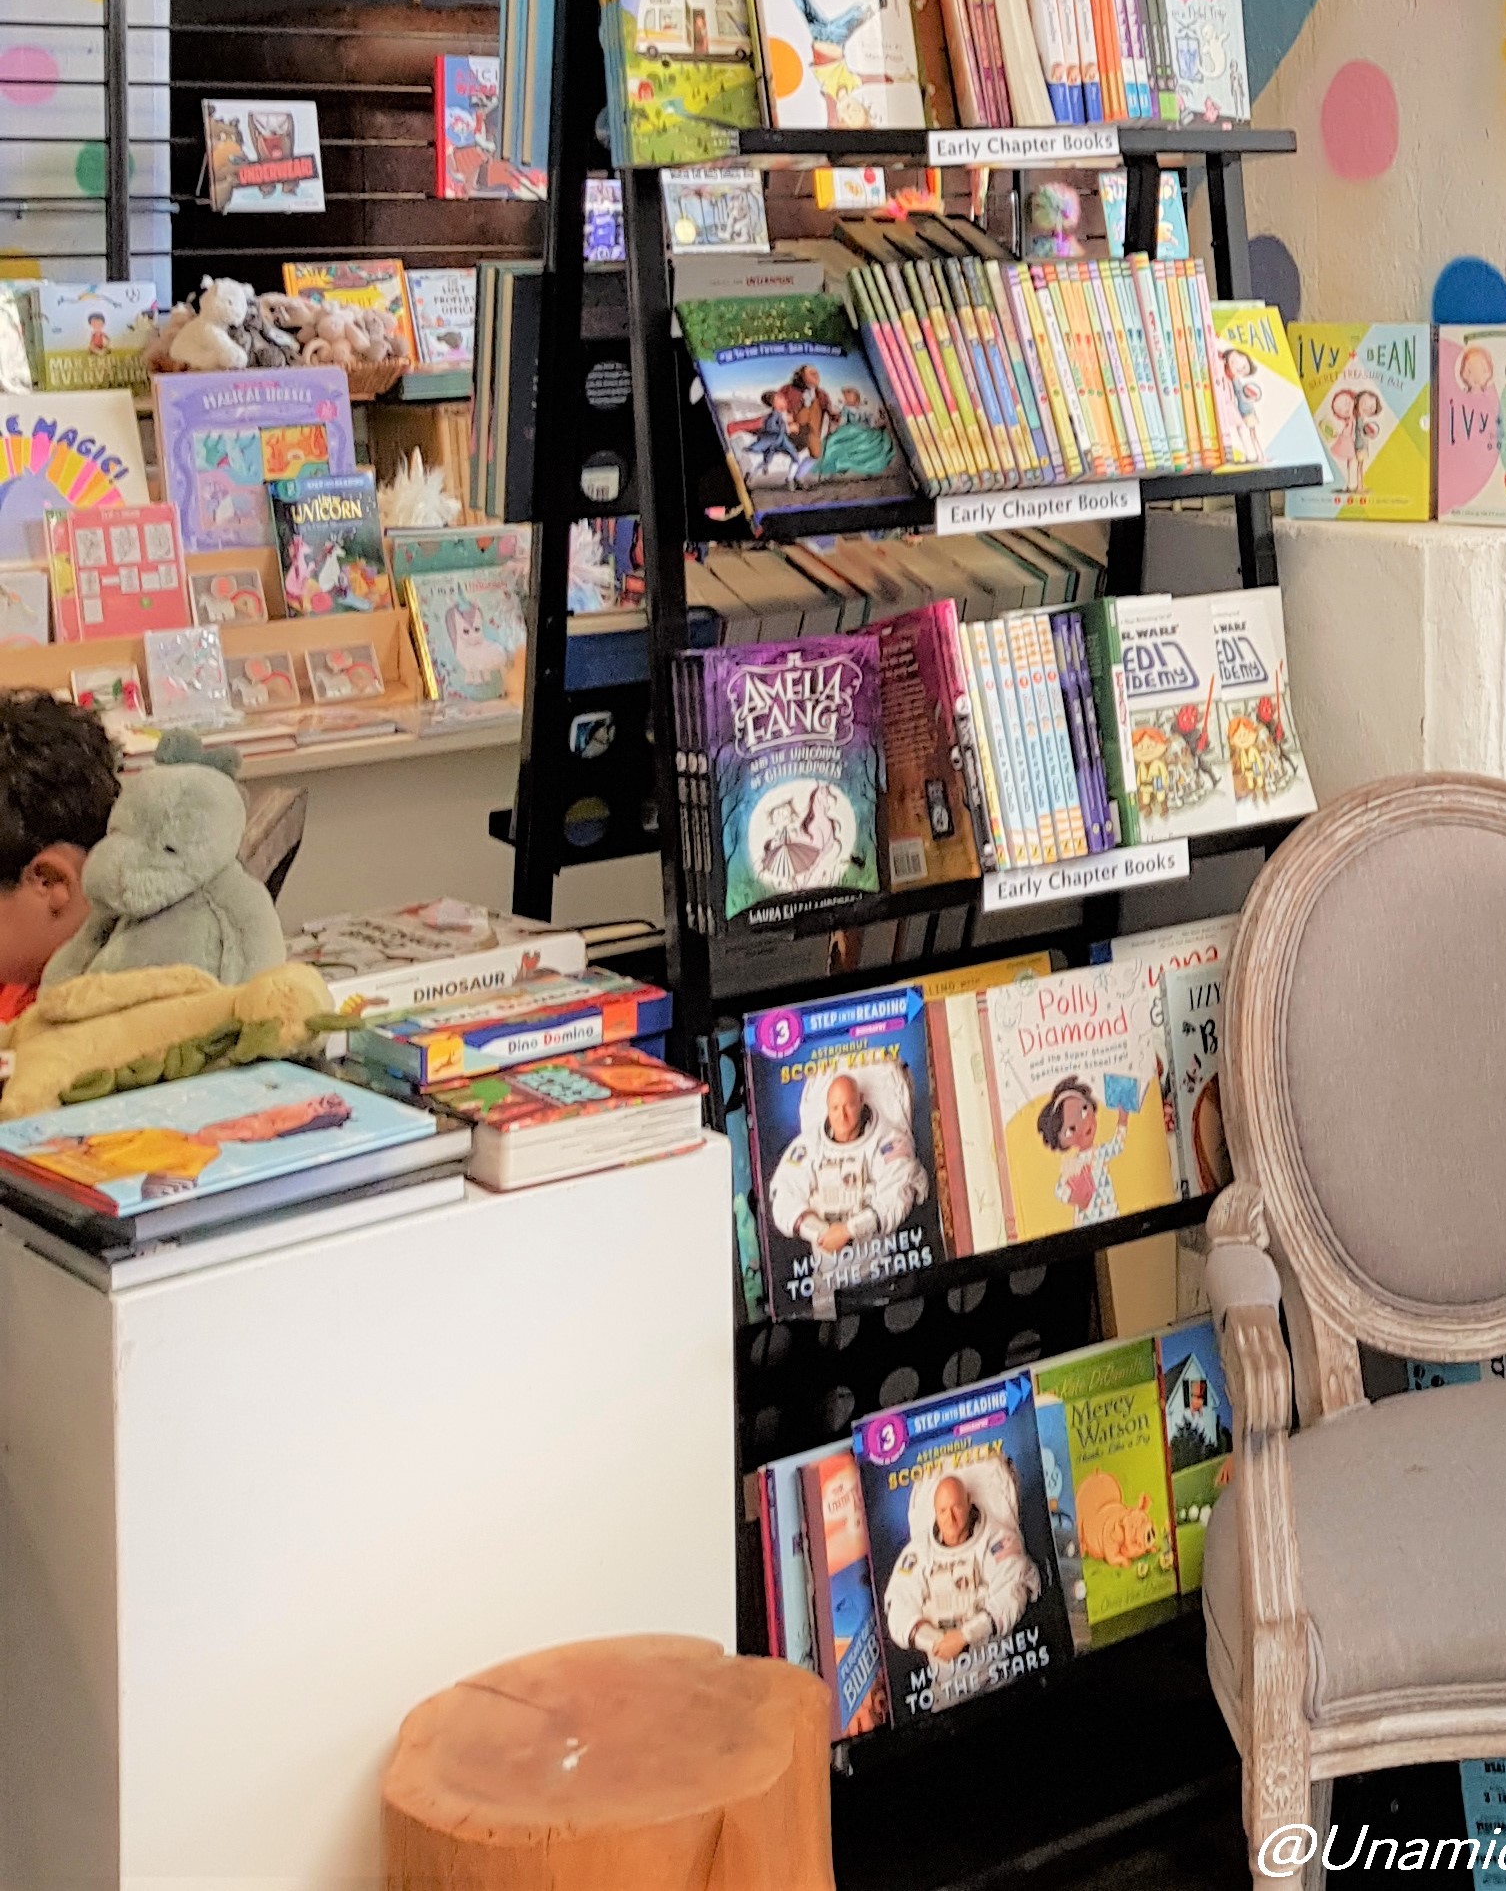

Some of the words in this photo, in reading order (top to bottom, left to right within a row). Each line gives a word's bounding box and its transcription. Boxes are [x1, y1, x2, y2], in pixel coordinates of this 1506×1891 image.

[937, 137, 981, 158] Early
[987, 135, 1056, 155] Chapter
[1063, 132, 1113, 151] Books
[1227, 313, 1277, 355] BEAN
[1366, 335, 1417, 381] BEAN
[292, 501, 362, 524] UNICORN
[950, 507, 996, 524] Early
[1003, 499, 1072, 521] Chapter
[1078, 493, 1128, 513] Books
[743, 664, 844, 712] AMELIA
[745, 703, 840, 746] FANG
[998, 881, 1042, 900] Early
[1049, 866, 1119, 892] Chapter
[1125, 855, 1176, 874] Books
[413, 971, 506, 1005] DINOSAUR
[1037, 983, 1099, 1021] Polly
[774, 1021, 791, 1045] 3
[810, 1011, 837, 1032] STEP
[856, 998, 908, 1022] READING
[1018, 1005, 1129, 1059] Diamond
[507, 1037, 539, 1056] Dino
[544, 1024, 595, 1048] Domino
[811, 1039, 869, 1059] ASTRONAUT
[780, 1060, 841, 1085] SCOTT
[846, 1044, 900, 1070] KELLY
[792, 1252, 821, 1278] MY
[836, 1226, 924, 1268] JOURNEY
[786, 1276, 816, 1302] TO
[822, 1265, 863, 1289] THE
[868, 1250, 934, 1281] STARS
[914, 1413, 941, 1433] STEP
[958, 1392, 1008, 1418] READING
[1071, 1393, 1135, 1428] Mercy
[1075, 1412, 1150, 1448] Watson
[878, 1424, 896, 1452] 3
[916, 1437, 973, 1463] ASTRONAUT
[888, 1457, 946, 1490] SCOTT
[951, 1439, 1005, 1471] KELLY
[843, 1633, 881, 1712] BLUEB
[909, 1664, 938, 1691] MY
[951, 1626, 1040, 1669] JOURNEY
[904, 1689, 936, 1715] TO
[943, 1672, 982, 1699] THE
[986, 1645, 1051, 1685] STARS
